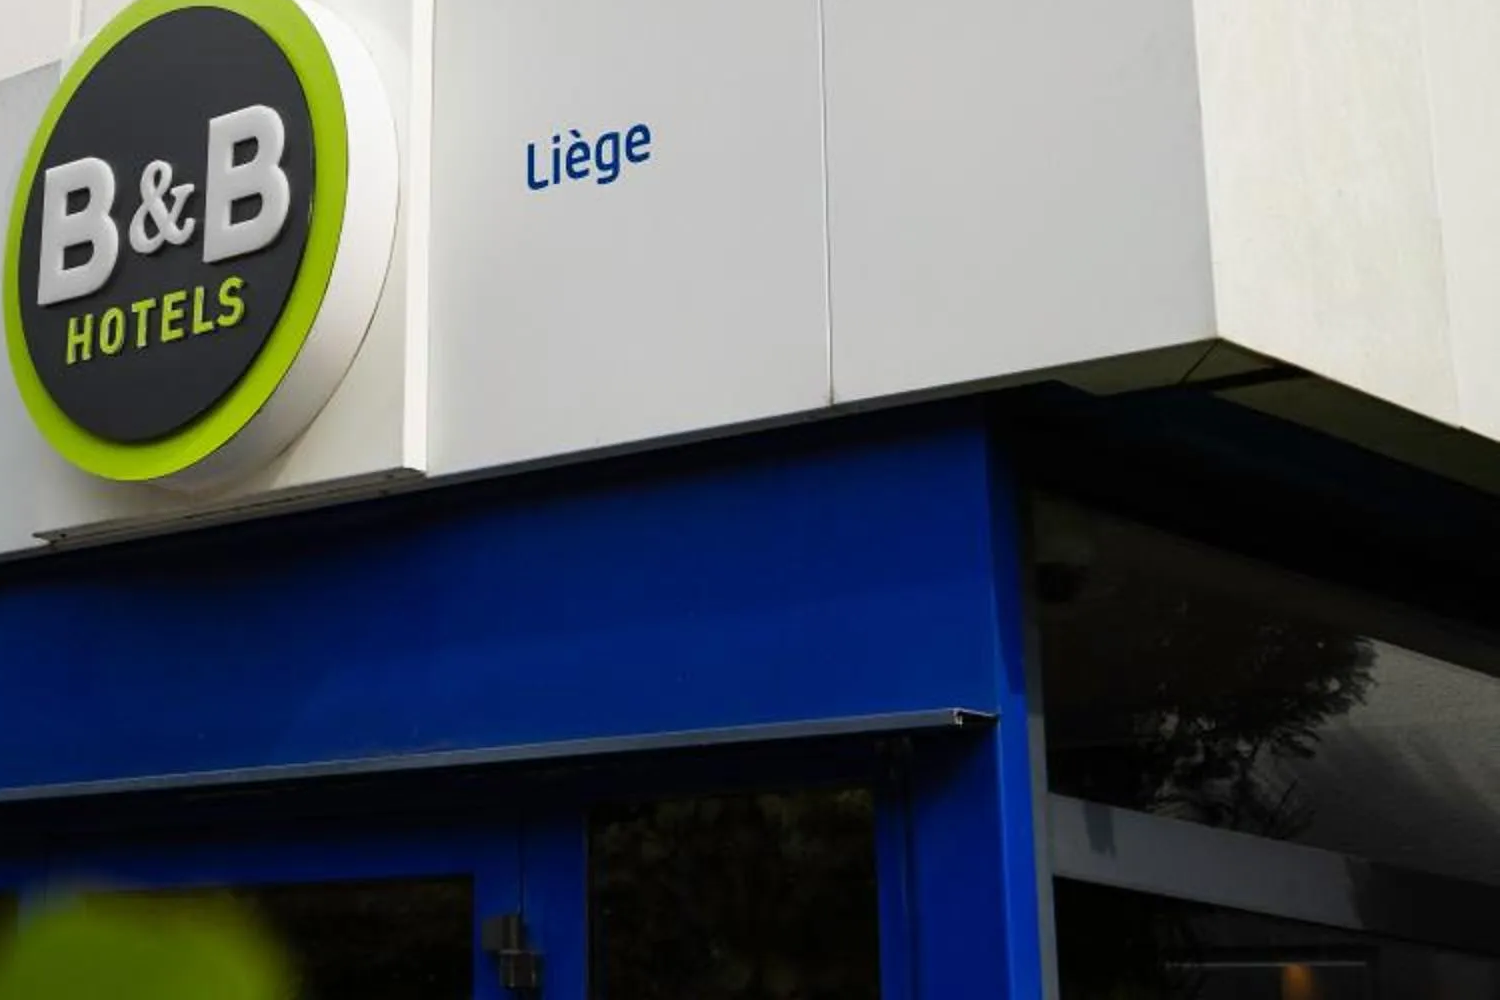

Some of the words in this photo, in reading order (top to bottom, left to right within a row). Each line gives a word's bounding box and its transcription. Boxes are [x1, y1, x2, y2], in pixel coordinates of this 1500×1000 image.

[527, 123, 651, 190] Liège
[37, 104, 291, 307] B&B
[66, 276, 247, 365] HOTELS
